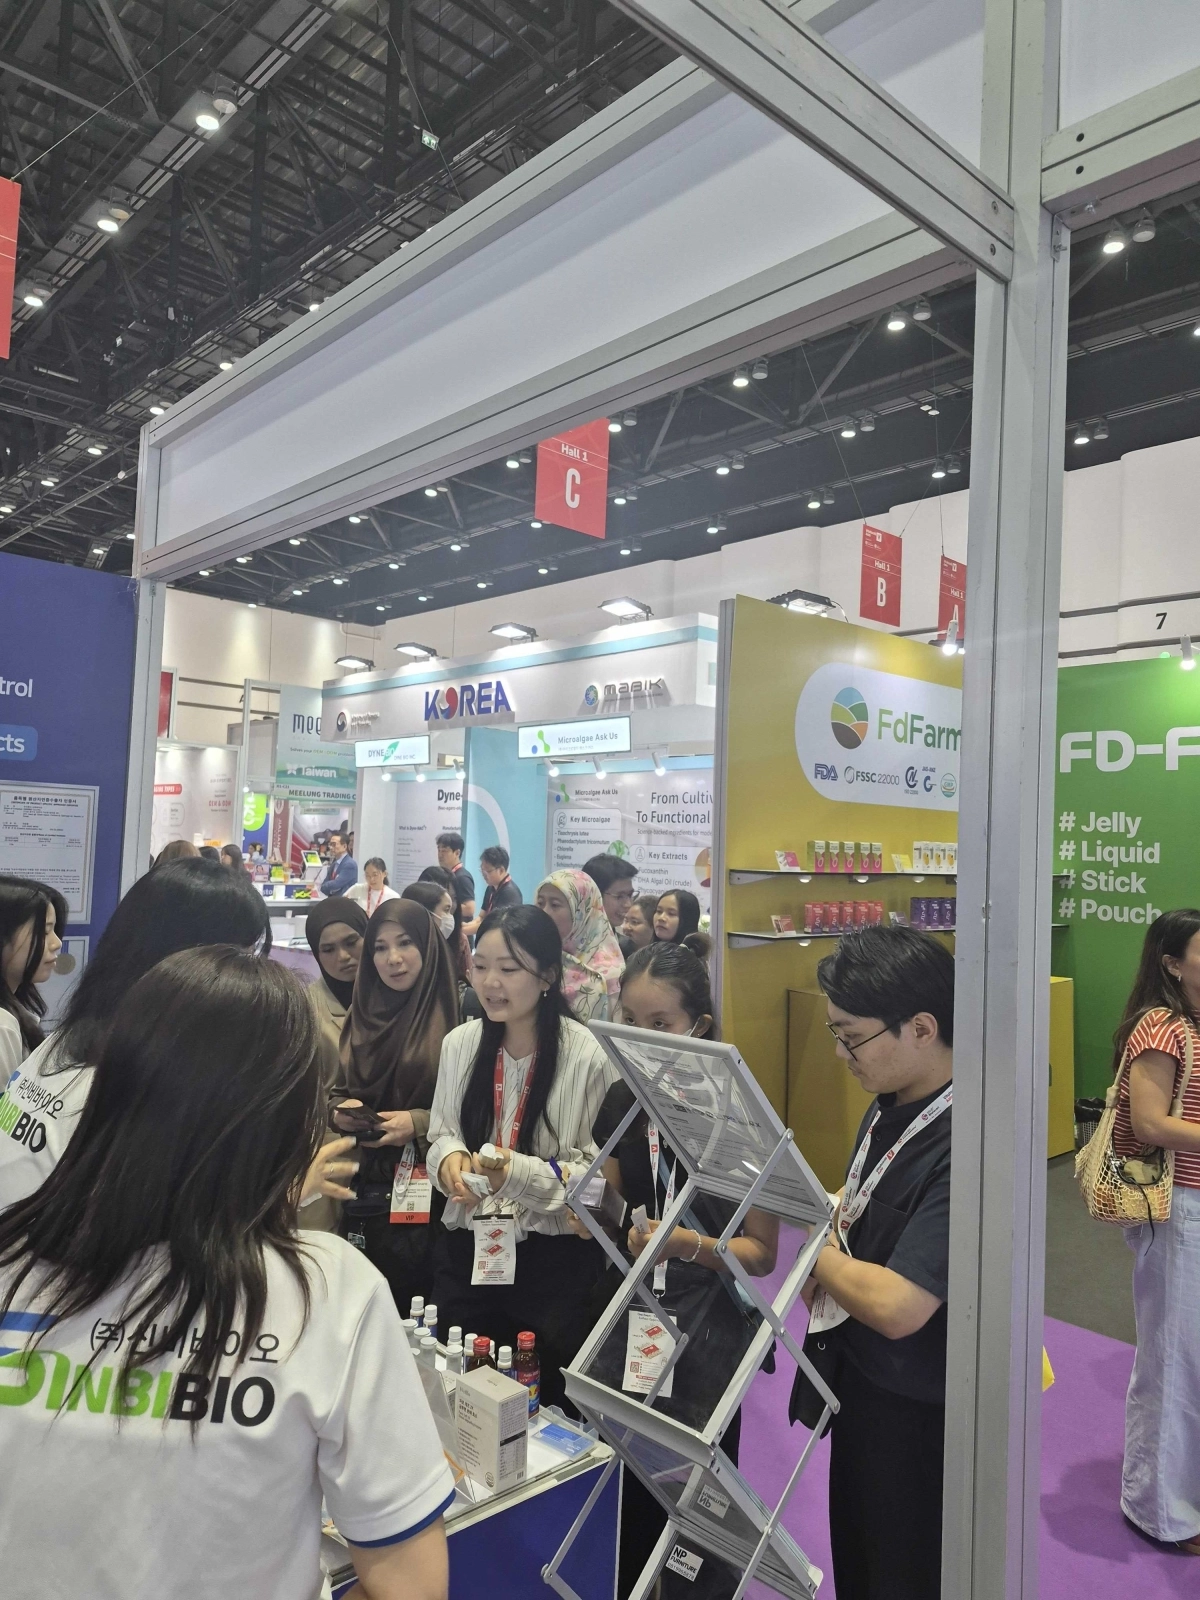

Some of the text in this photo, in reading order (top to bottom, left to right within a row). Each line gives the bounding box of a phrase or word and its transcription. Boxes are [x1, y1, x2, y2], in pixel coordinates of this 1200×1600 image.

[561, 443, 588, 462] Hall 1
[565, 467, 581, 509] C
[874, 560, 886, 571] Hall
[876, 576, 887, 607] B
[950, 587, 960, 598] Hall
[1155, 612, 1168, 630] 7
[557, 731, 618, 745] Microalgae Ask Us
[367, 748, 385, 758] DYNE
[300, 766, 337, 779] Taiwan
[813, 762, 839, 782] FDA
[855, 769, 900, 786] FSSC 22000
[288, 789, 321, 798] MEELUNG
[322, 791, 351, 800] TRADING
[574, 789, 601, 797] Microalgae
[650, 792, 679, 805] From
[570, 816, 611, 824] Key Microalgae
[636, 810, 711, 824] To Functional
[1080, 811, 1142, 839] Jelly
[648, 851, 688, 861] Key Extracts
[1081, 840, 1161, 868] Liquid
[672, 879, 692, 887] (crude)
[1081, 869, 1147, 894] Stick
[1081, 898, 1163, 925] Pouch
[673, 1546, 688, 1559] NP
[669, 1555, 697, 1574] FURNITURE
